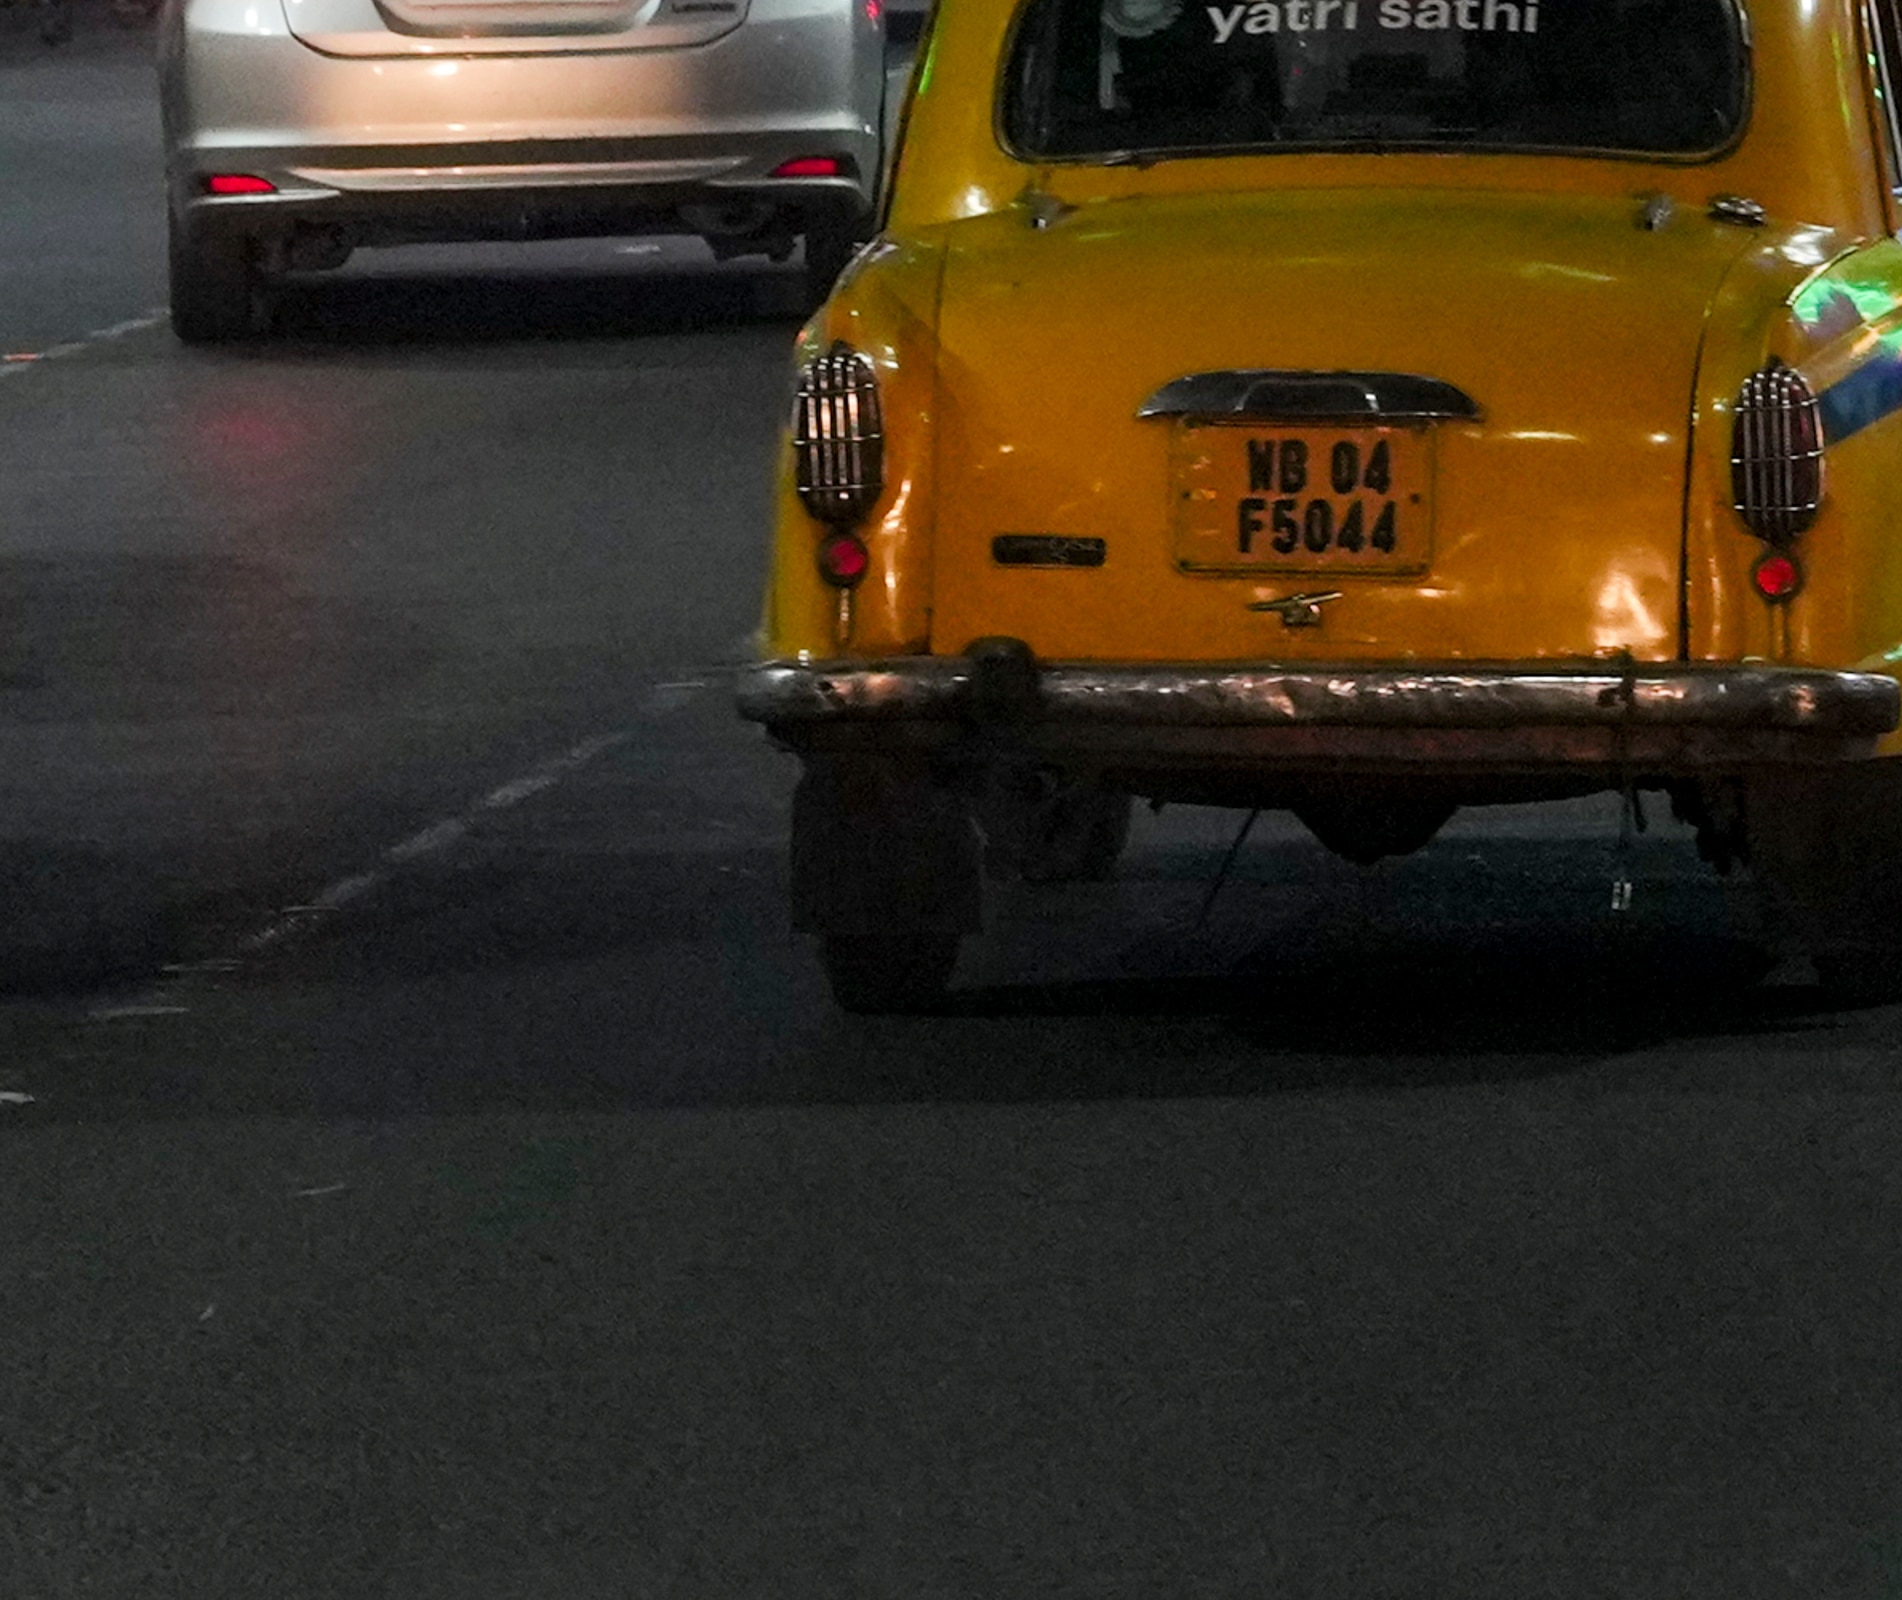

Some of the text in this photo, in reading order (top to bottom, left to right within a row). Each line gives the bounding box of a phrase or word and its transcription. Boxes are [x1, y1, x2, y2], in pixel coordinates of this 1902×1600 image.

[1247, 438, 1393, 495] WB 04
[1237, 498, 1398, 555] F5044
